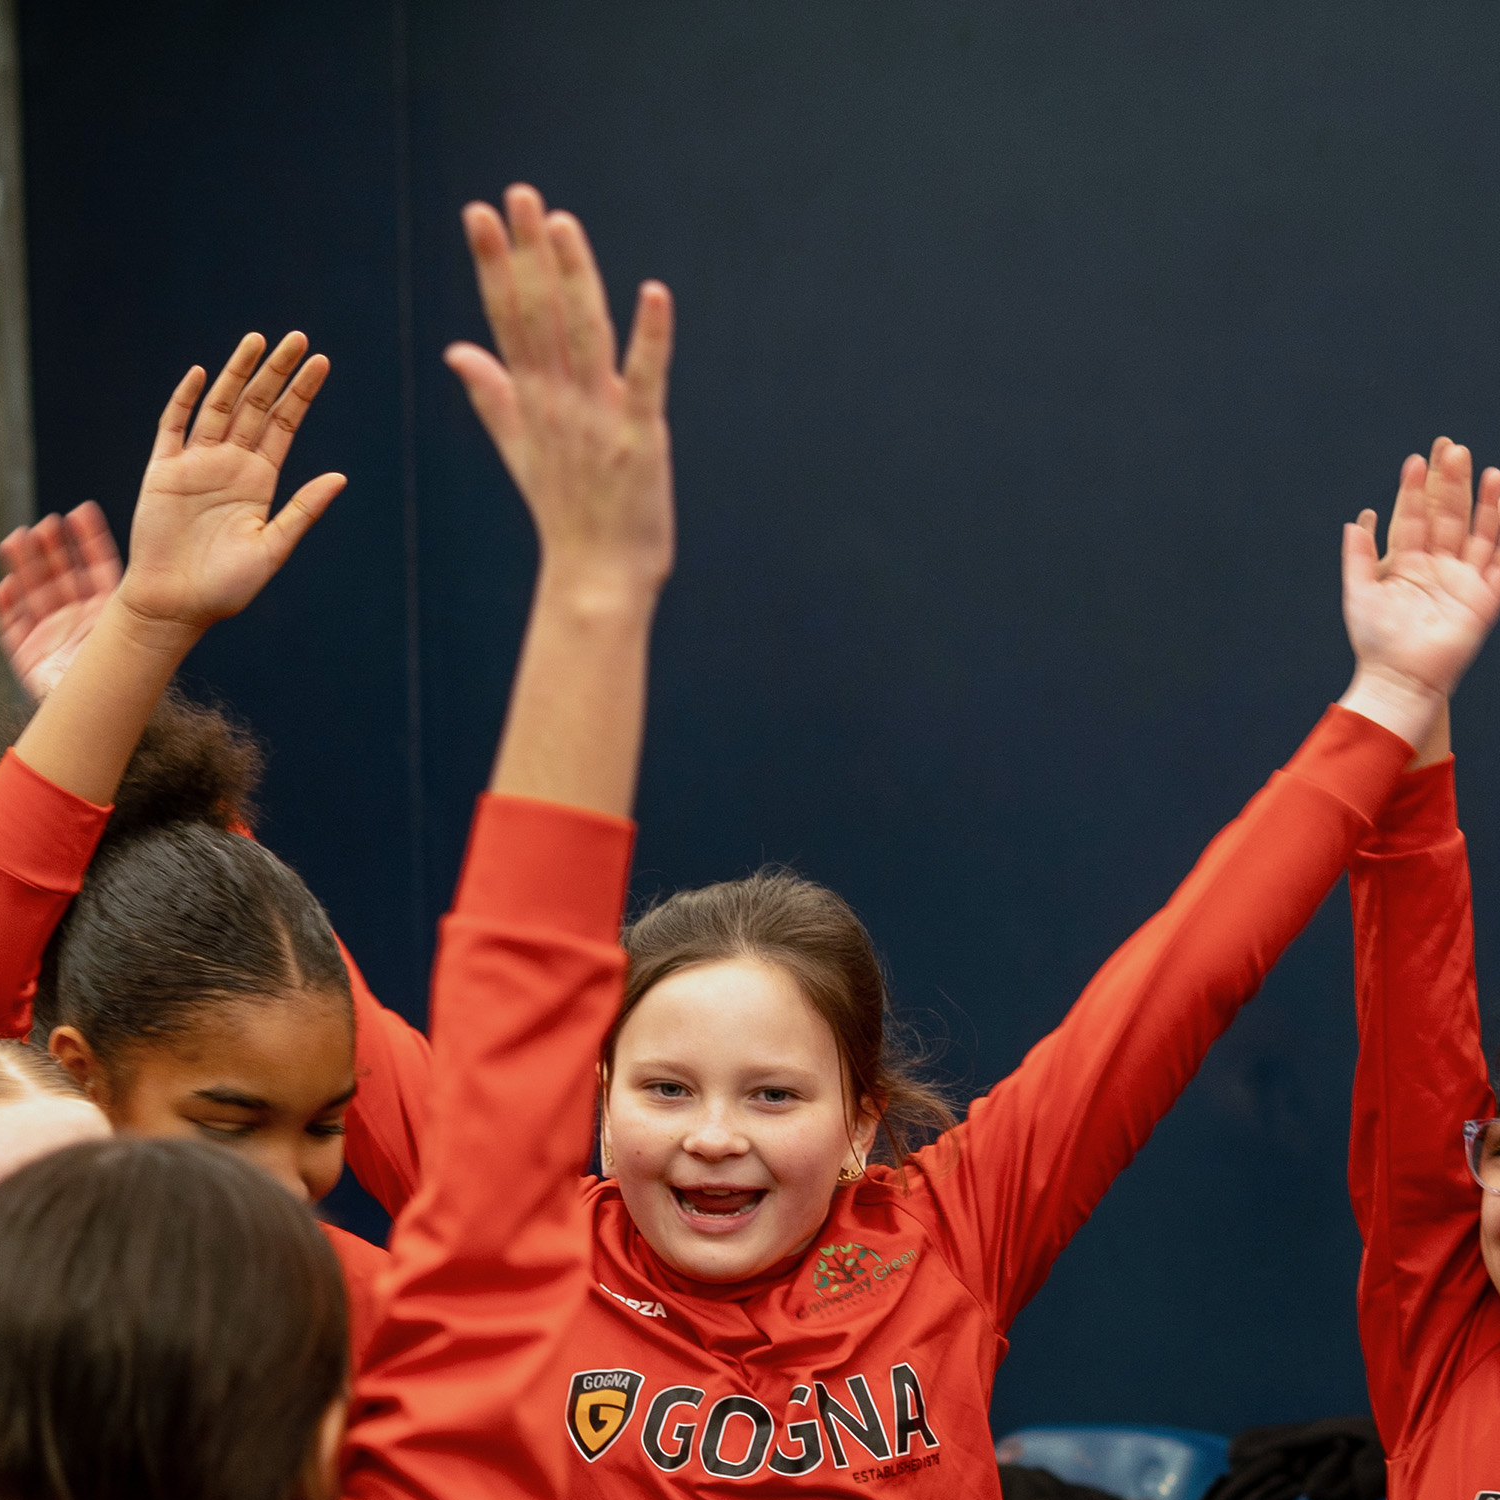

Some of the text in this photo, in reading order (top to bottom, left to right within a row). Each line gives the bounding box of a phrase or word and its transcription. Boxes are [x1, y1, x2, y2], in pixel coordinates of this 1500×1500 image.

[872, 1249, 918, 1281] Green
[582, 1373, 631, 1390] GOGNA
[640, 1362, 940, 1480] GOGNA
